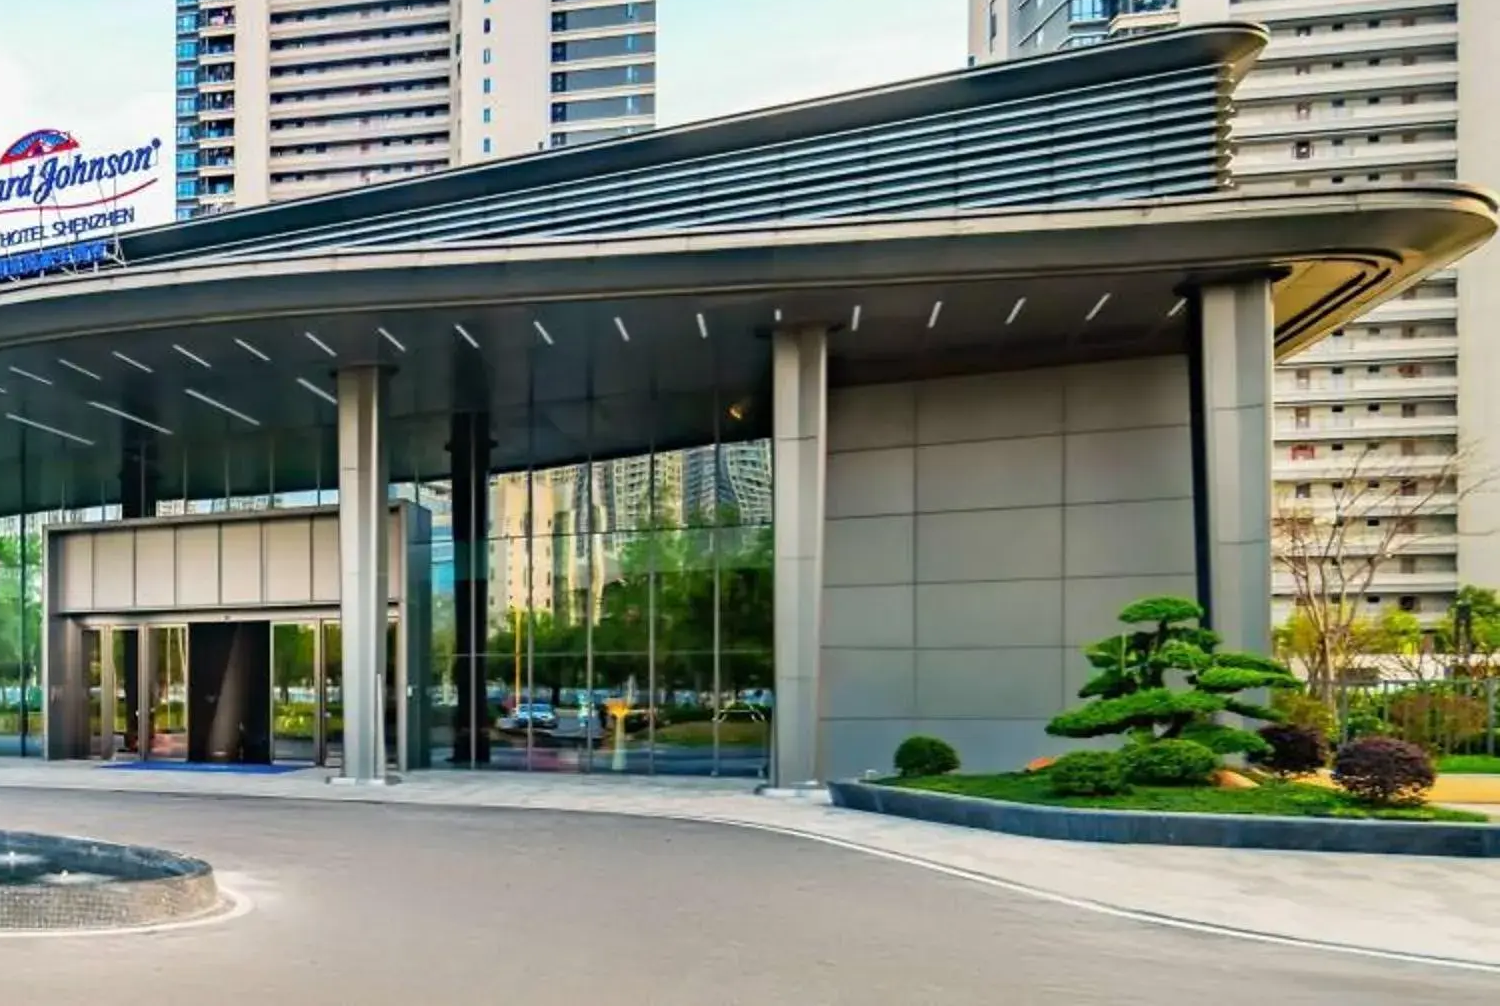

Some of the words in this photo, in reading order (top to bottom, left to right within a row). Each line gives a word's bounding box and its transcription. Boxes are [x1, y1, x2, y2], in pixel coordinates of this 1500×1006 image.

[33, 143, 152, 205] Johnson
[0, 225, 48, 246] HOTEL
[52, 206, 135, 237] SHENZHEN
